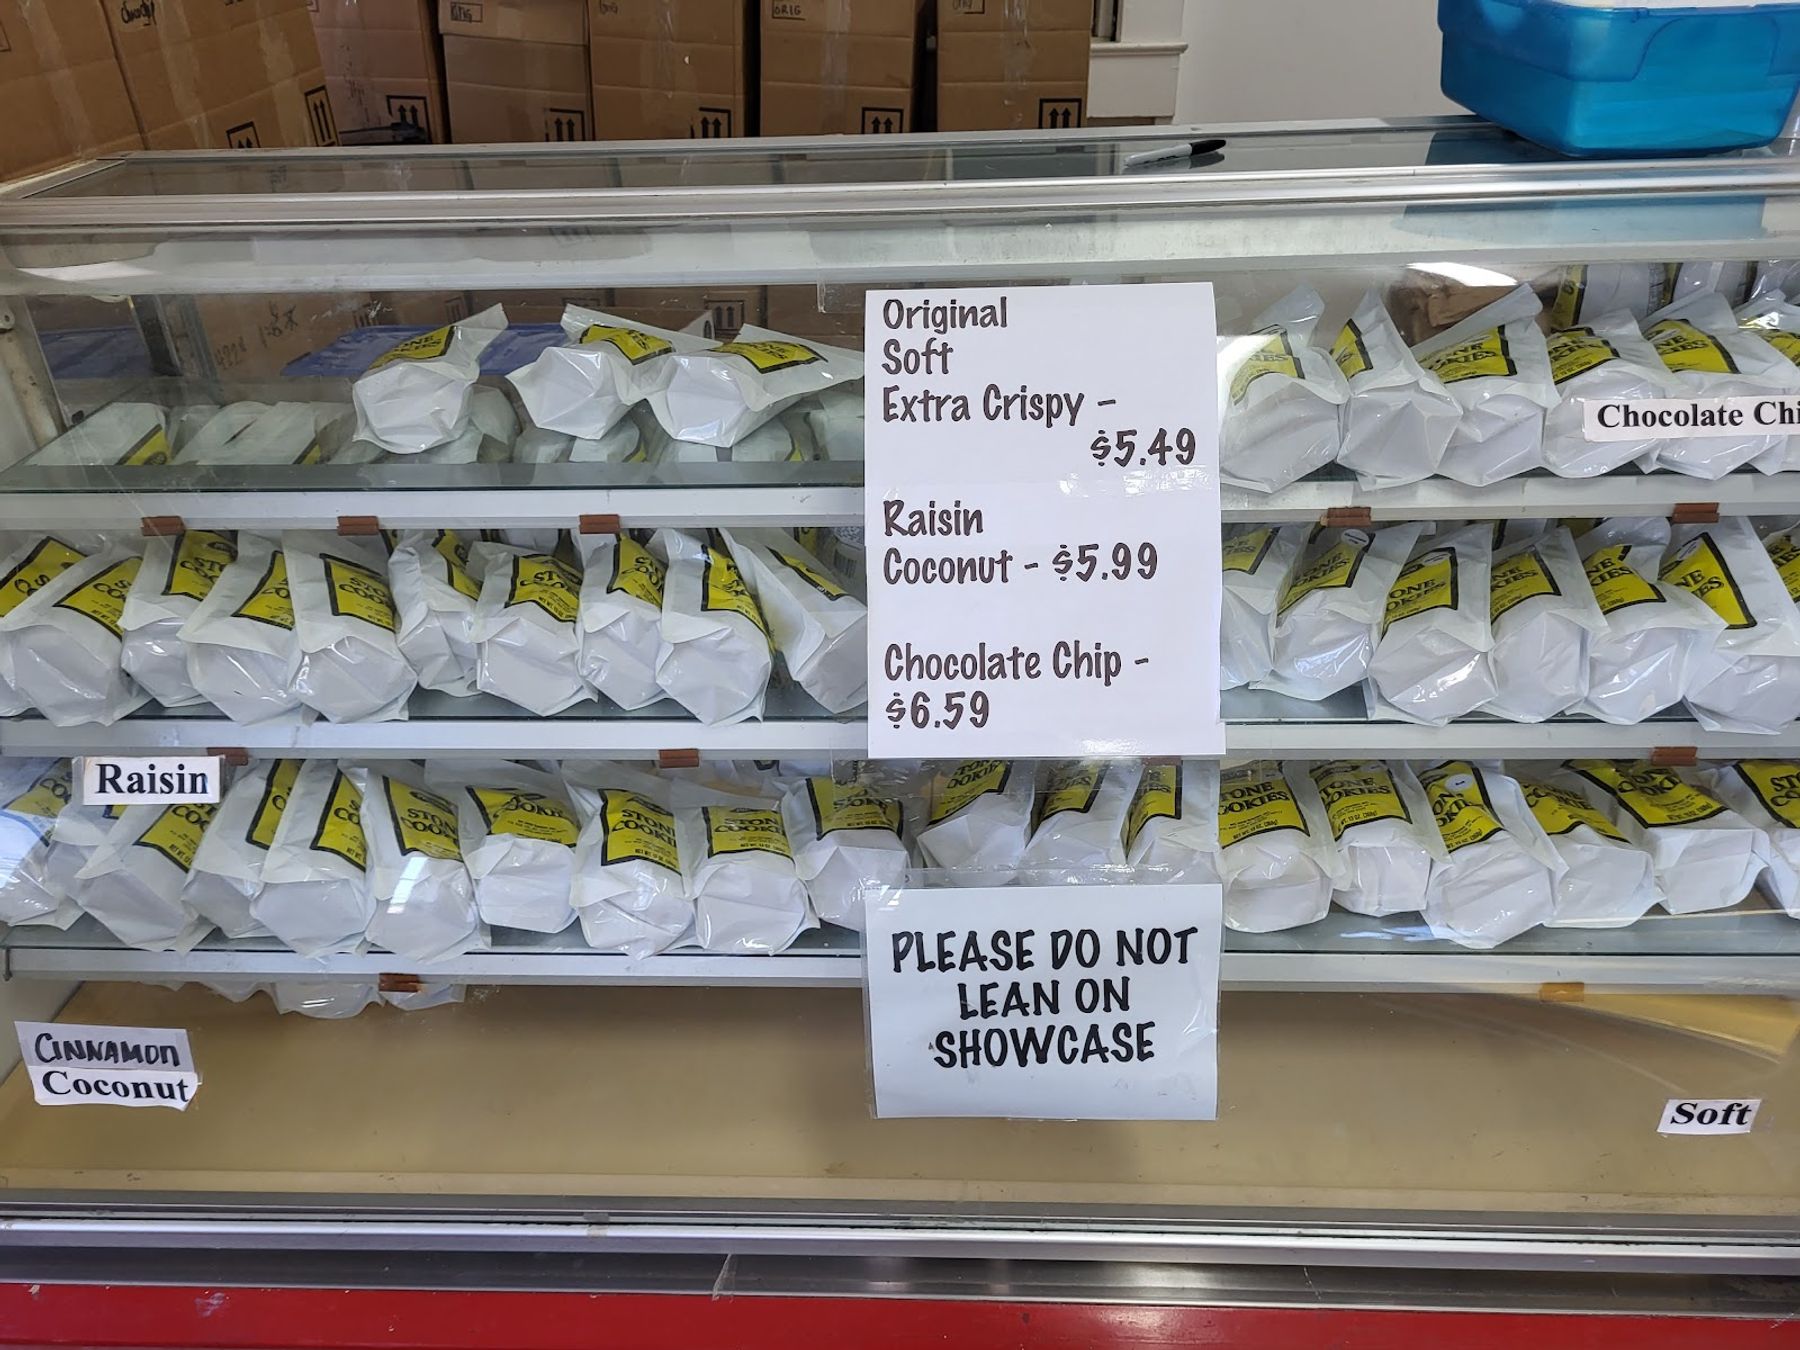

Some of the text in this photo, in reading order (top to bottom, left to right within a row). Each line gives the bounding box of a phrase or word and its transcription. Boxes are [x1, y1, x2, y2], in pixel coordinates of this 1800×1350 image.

[883, 297, 1008, 334] Original
[882, 337, 953, 375] Soft
[883, 385, 970, 423] Extra
[983, 384, 1085, 428] Crispy
[1597, 403, 1744, 428] Chocolate
[1090, 428, 1197, 467] $5.49
[884, 499, 984, 537] Raisin
[884, 547, 1013, 585] Coconut
[1052, 542, 1158, 583] $5.99
[884, 642, 1041, 681] Chocolate
[1053, 640, 1122, 686] Chip
[886, 690, 990, 729] $6.59
[95, 763, 209, 795] Raisin
[891, 927, 1198, 973] PLEASE DO NOT
[958, 976, 1130, 1020] LEAN ON
[933, 1021, 1156, 1068] SHOWCASE
[42, 1070, 190, 1102] Coconut
[1670, 1102, 1752, 1126] Soft
